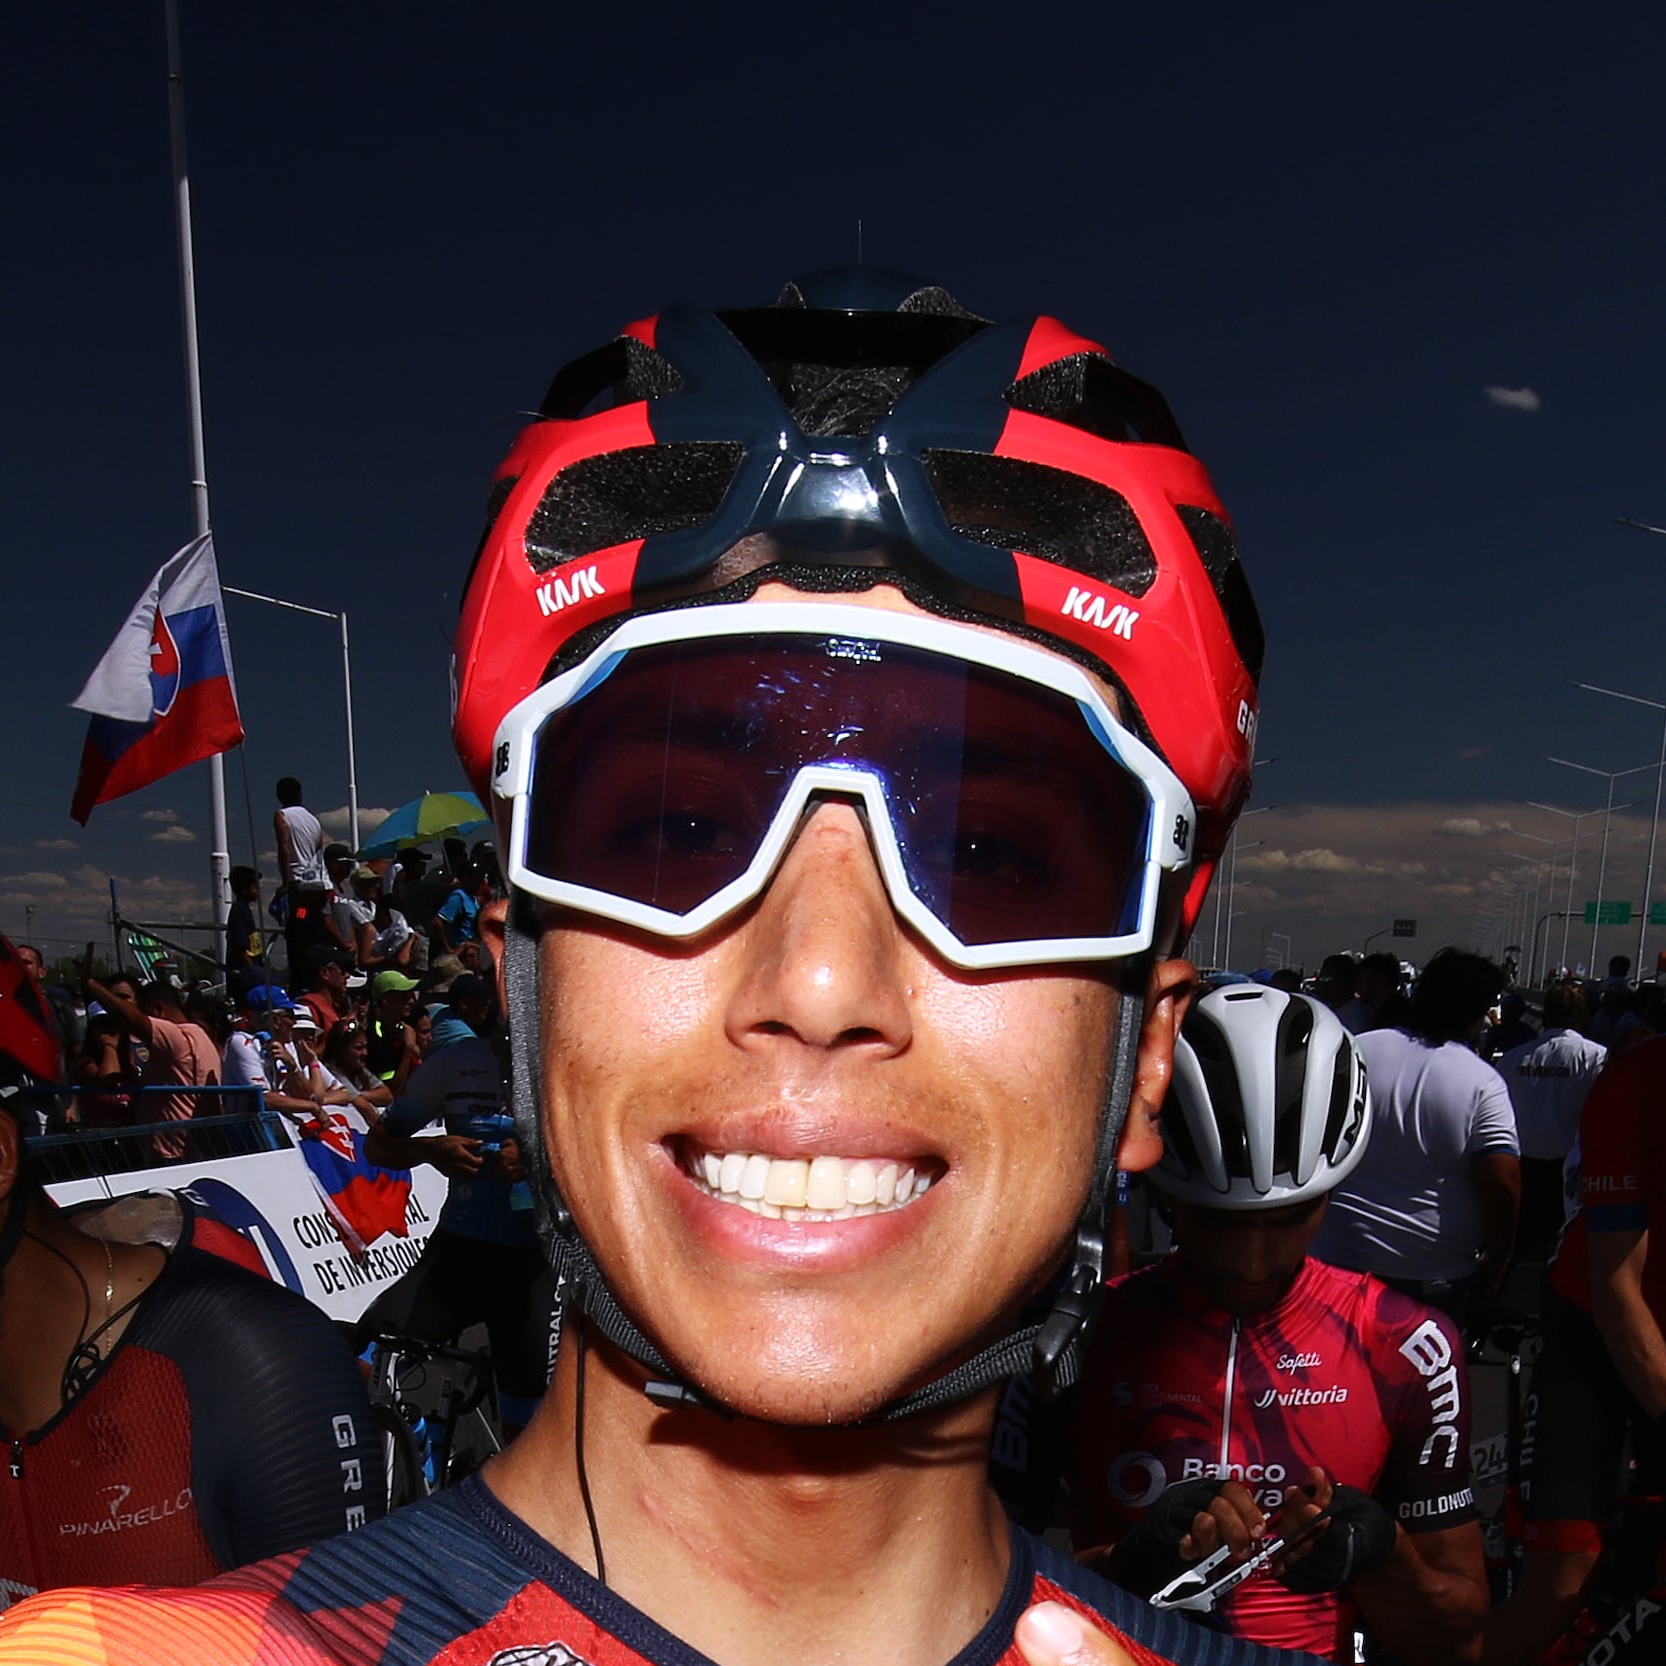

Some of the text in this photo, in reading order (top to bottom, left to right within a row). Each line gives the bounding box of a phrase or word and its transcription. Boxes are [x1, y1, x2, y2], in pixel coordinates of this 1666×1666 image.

[536, 565, 606, 617] KASK
[1061, 586, 1141, 641] KASK
[314, 1259, 345, 1294] DE
[1276, 1353, 1322, 1376] Safetti
[1277, 1385, 1349, 1408] vittoria
[1183, 1457, 1287, 1482] Banco
[60, 1488, 194, 1537] PINARELLO
